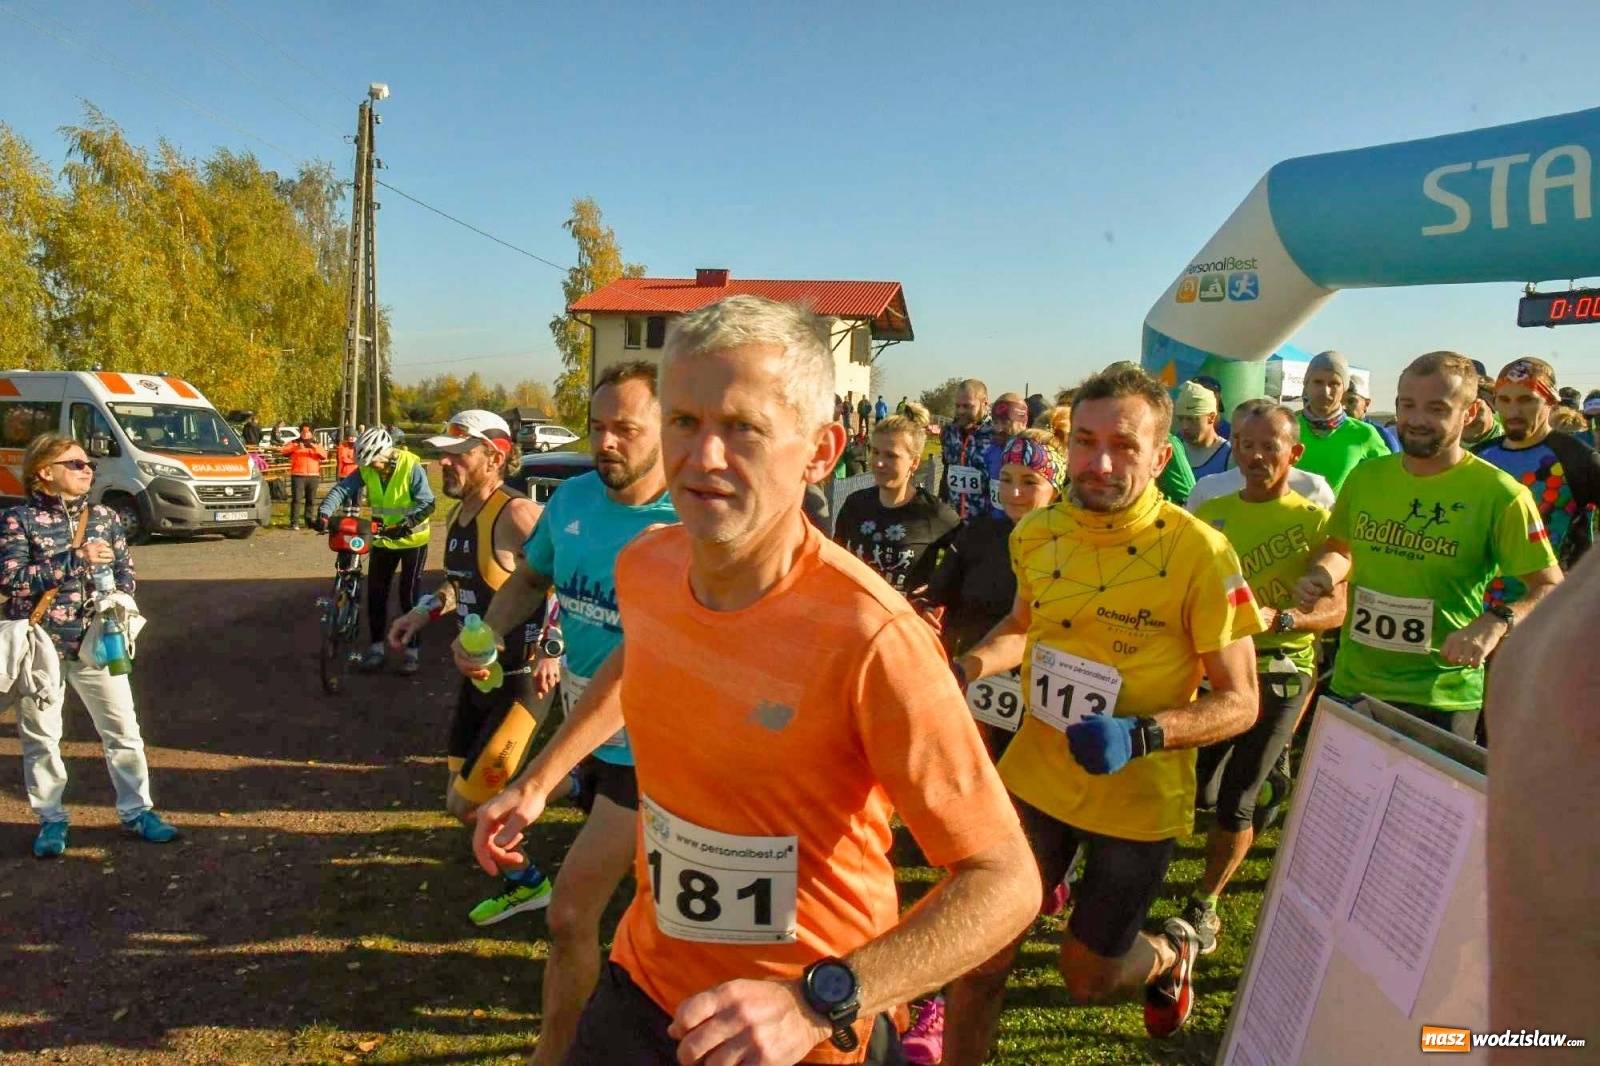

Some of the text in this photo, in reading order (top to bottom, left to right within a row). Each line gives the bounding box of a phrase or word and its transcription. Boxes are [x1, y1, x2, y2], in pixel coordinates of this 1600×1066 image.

[1421, 144, 1592, 236] STA
[949, 475, 979, 489] 218
[559, 594, 621, 625] warsaw
[1354, 608, 1425, 643] 208
[973, 684, 1019, 718] 39
[1036, 674, 1107, 719] 113
[676, 834, 788, 860] www.personalbest.pl
[648, 849, 772, 926] 181
